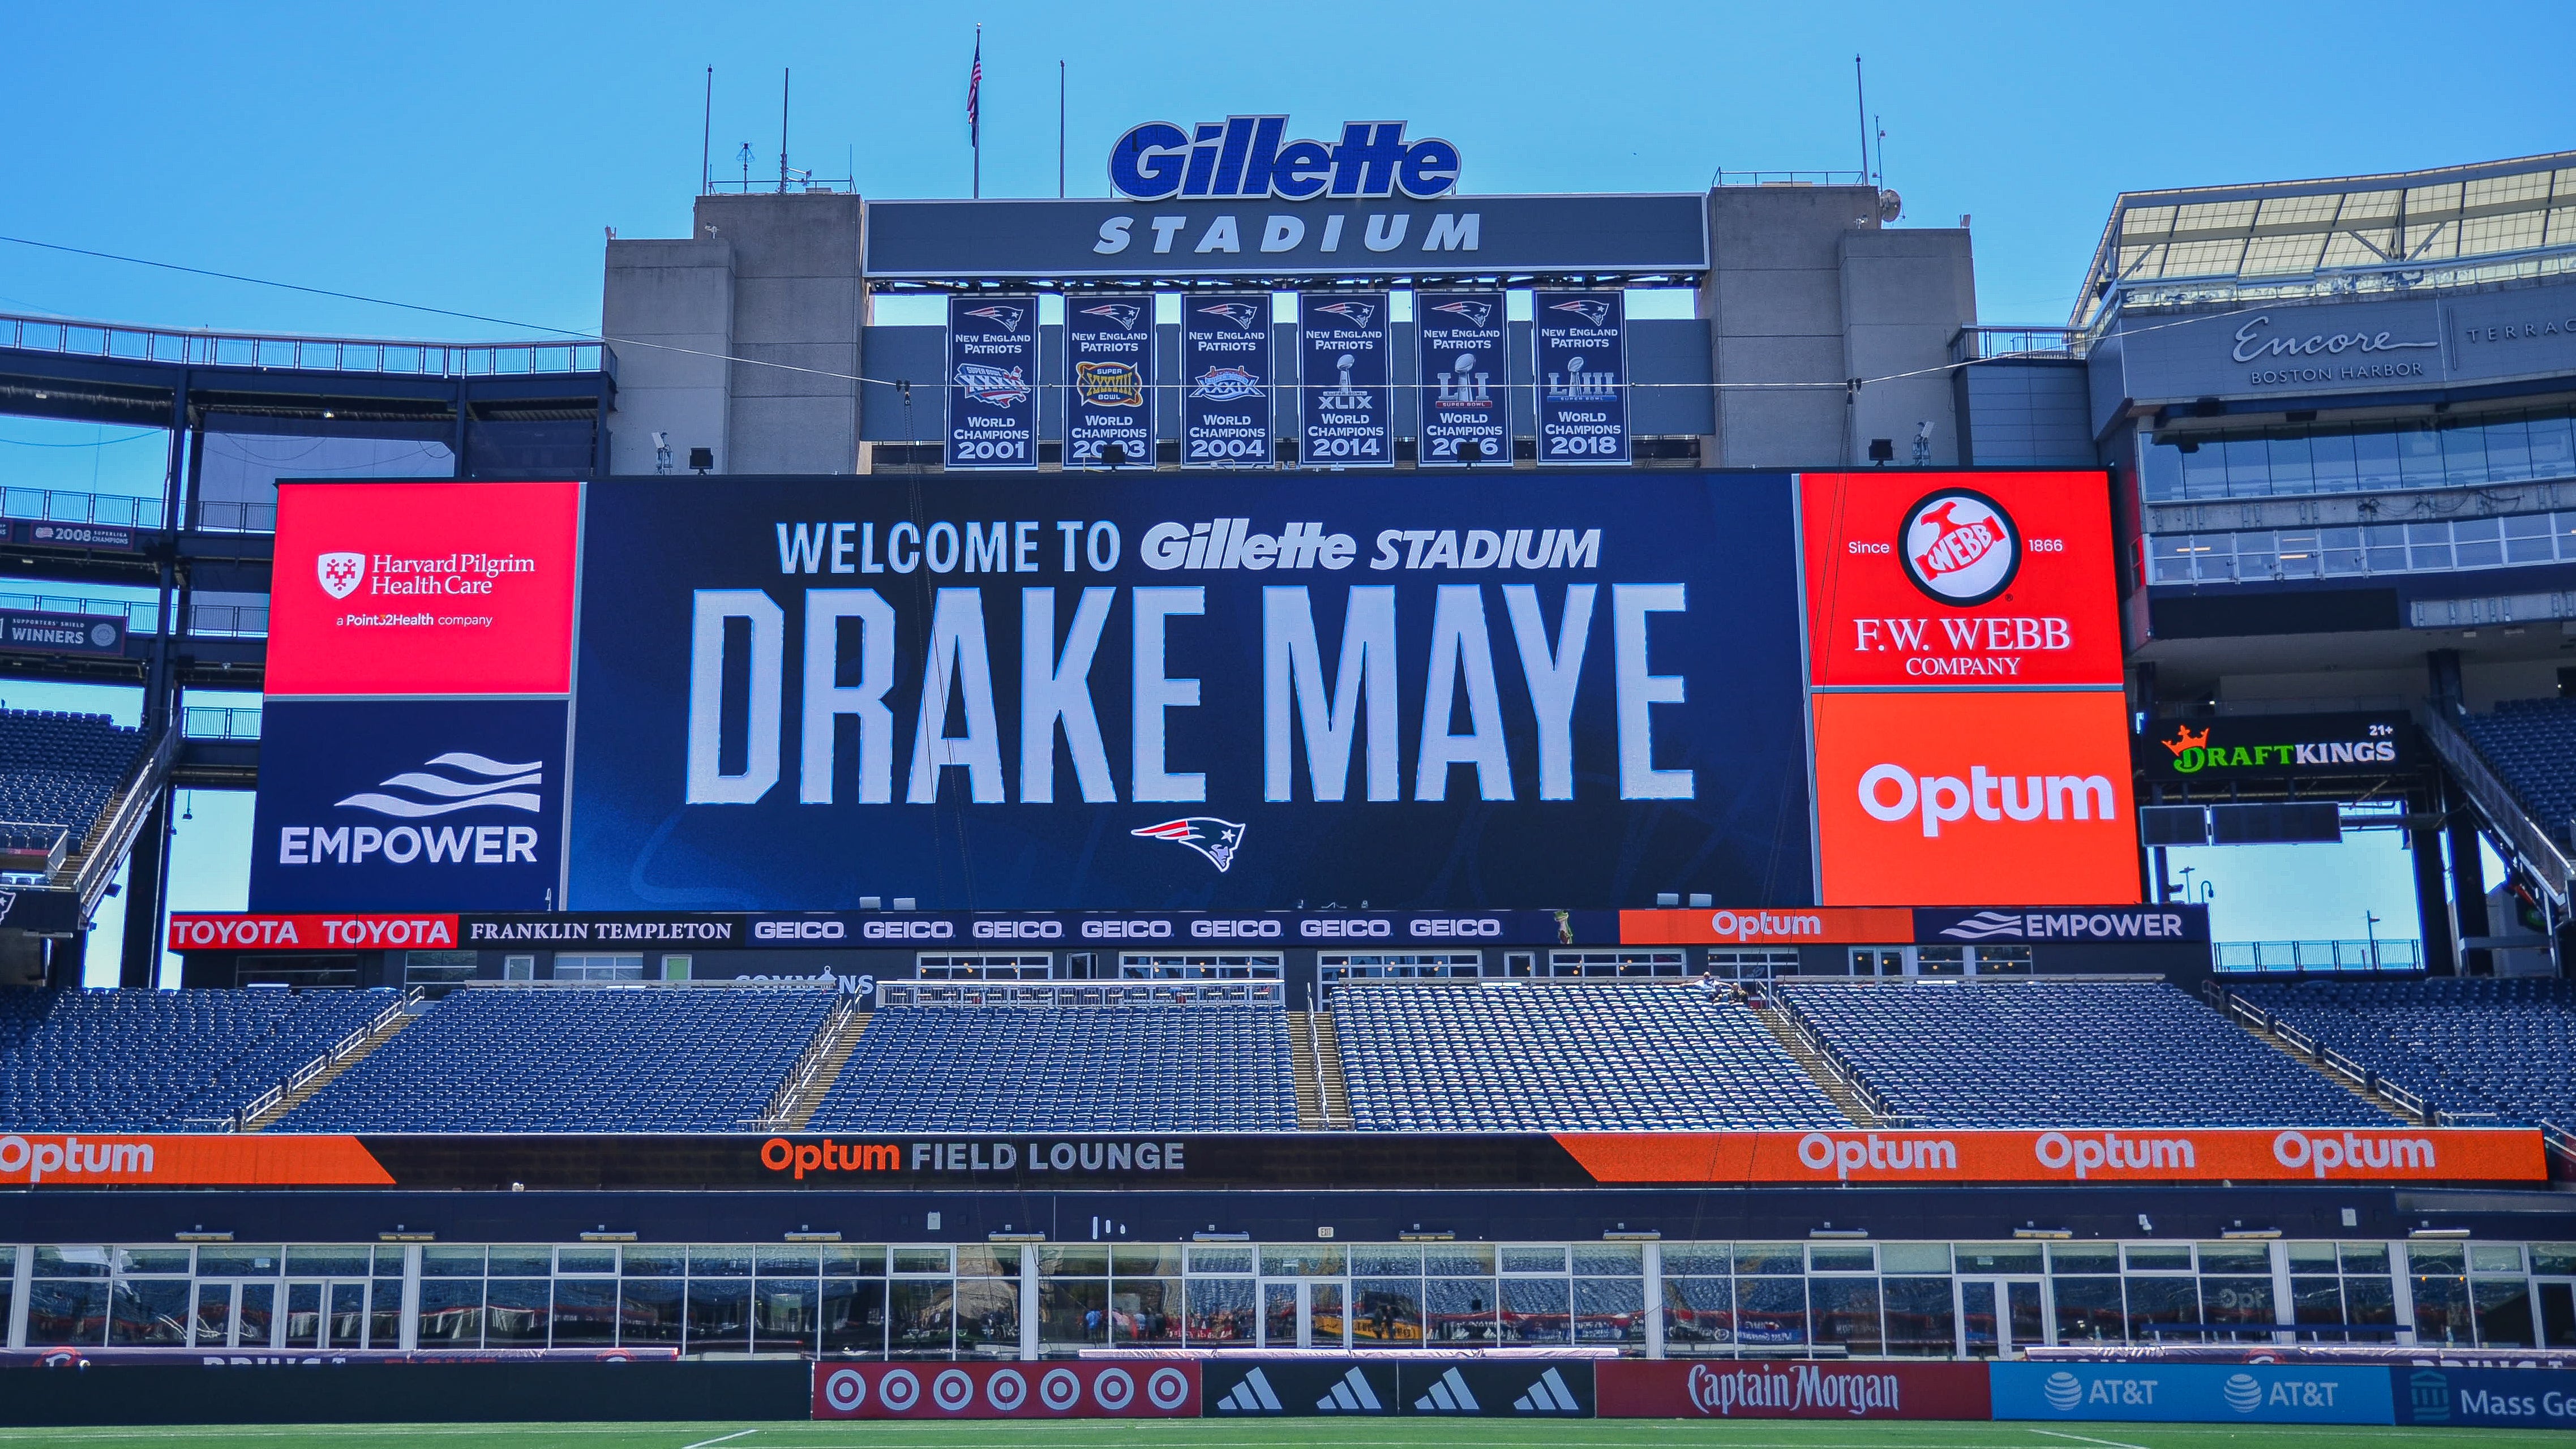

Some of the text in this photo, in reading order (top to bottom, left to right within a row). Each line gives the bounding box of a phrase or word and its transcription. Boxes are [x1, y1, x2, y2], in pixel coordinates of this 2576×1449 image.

[1108, 115, 1461, 200] Gillette
[1093, 214, 1480, 254] STADIUM
[1334, 330, 1382, 338] ENGLAND
[1551, 338, 1609, 348] PATRIOTS
[2232, 316, 2438, 362] Encore
[965, 344, 1022, 354] PATRIOTS
[1081, 342, 1138, 351] PATRIOTS
[1198, 342, 1256, 351] PATRIOTS
[1315, 340, 1373, 350] PATRIOTS
[1434, 340, 1491, 349] PATRIOTS
[2251, 363, 2423, 385] BOSTON HARBOR
[1549, 372, 1614, 395] LIII
[1318, 396, 1373, 409] XLIX
[968, 417, 1015, 427] WORLD
[1085, 415, 1133, 426] WORLD
[1203, 415, 1251, 425] WORLD
[1322, 414, 1369, 424] WORLD
[1440, 413, 1488, 423] WORLD
[1558, 411, 1606, 422] WORLD
[954, 429, 1029, 439] CHAMPIONS
[1072, 428, 1147, 438] CHAMPIONS
[1190, 427, 1265, 438] CHAMPIONS
[1308, 426, 1384, 436] CHAMPIONS
[1427, 426, 1503, 436] CHAMPIONS
[1545, 424, 1621, 435] CHAMPIONS
[958, 441, 1025, 459] 2001
[1191, 439, 1265, 457] 2004
[1313, 438, 1380, 456] 2014
[1433, 438, 1498, 456] 206
[1551, 436, 1617, 454] 2018
[55, 528, 92, 542] 2008
[776, 518, 1601, 573] WELCOME TO Gillette STADIUM
[1849, 524, 2063, 572] Since WEBB 1866
[372, 554, 535, 578] Harvard Pilgrim
[371, 575, 492, 595] Health Care
[336, 613, 492, 628] a Point32Health company
[12, 628, 84, 644] WINNERS
[1853, 617, 2070, 651] F.W. WEBB
[1905, 657, 2021, 676] COMPANY
[684, 583, 1696, 805] DRAKE MAYE
[2369, 724, 2393, 737] 21+
[2174, 741, 2395, 773] DRAFTKINGS
[1858, 764, 2115, 837] Optum
[280, 826, 538, 863] EMPOWER
[173, 920, 298, 944] TOYOTA
[323, 920, 450, 944] TOYOTA
[471, 923, 732, 940] FRANKLIN TEMPLETON
[755, 921, 844, 938] GEICO
[864, 921, 953, 938] GEICO
[972, 920, 1062, 938] GEICO
[1082, 920, 1171, 938] GEICO
[1191, 920, 1281, 937] GEICO
[1300, 920, 1390, 937] GEICO
[1410, 919, 1500, 937] GEICO
[1712, 910, 1821, 942] Optum
[2027, 914, 2181, 936] EMPOWER
[0, 1135, 155, 1182] Optum
[761, 1138, 1184, 1179] Optum FIELD LOUNGE
[1797, 1132, 1957, 1178] Optum
[2035, 1132, 2195, 1178] Optum
[2273, 1131, 2435, 1177] Optum
[1687, 1364, 1899, 1414] Captain Morgan
[2089, 1379, 2158, 1404] AT&T
[2269, 1381, 2338, 1407] AT&T
[2461, 1389, 2576, 1416] Mass Ge
